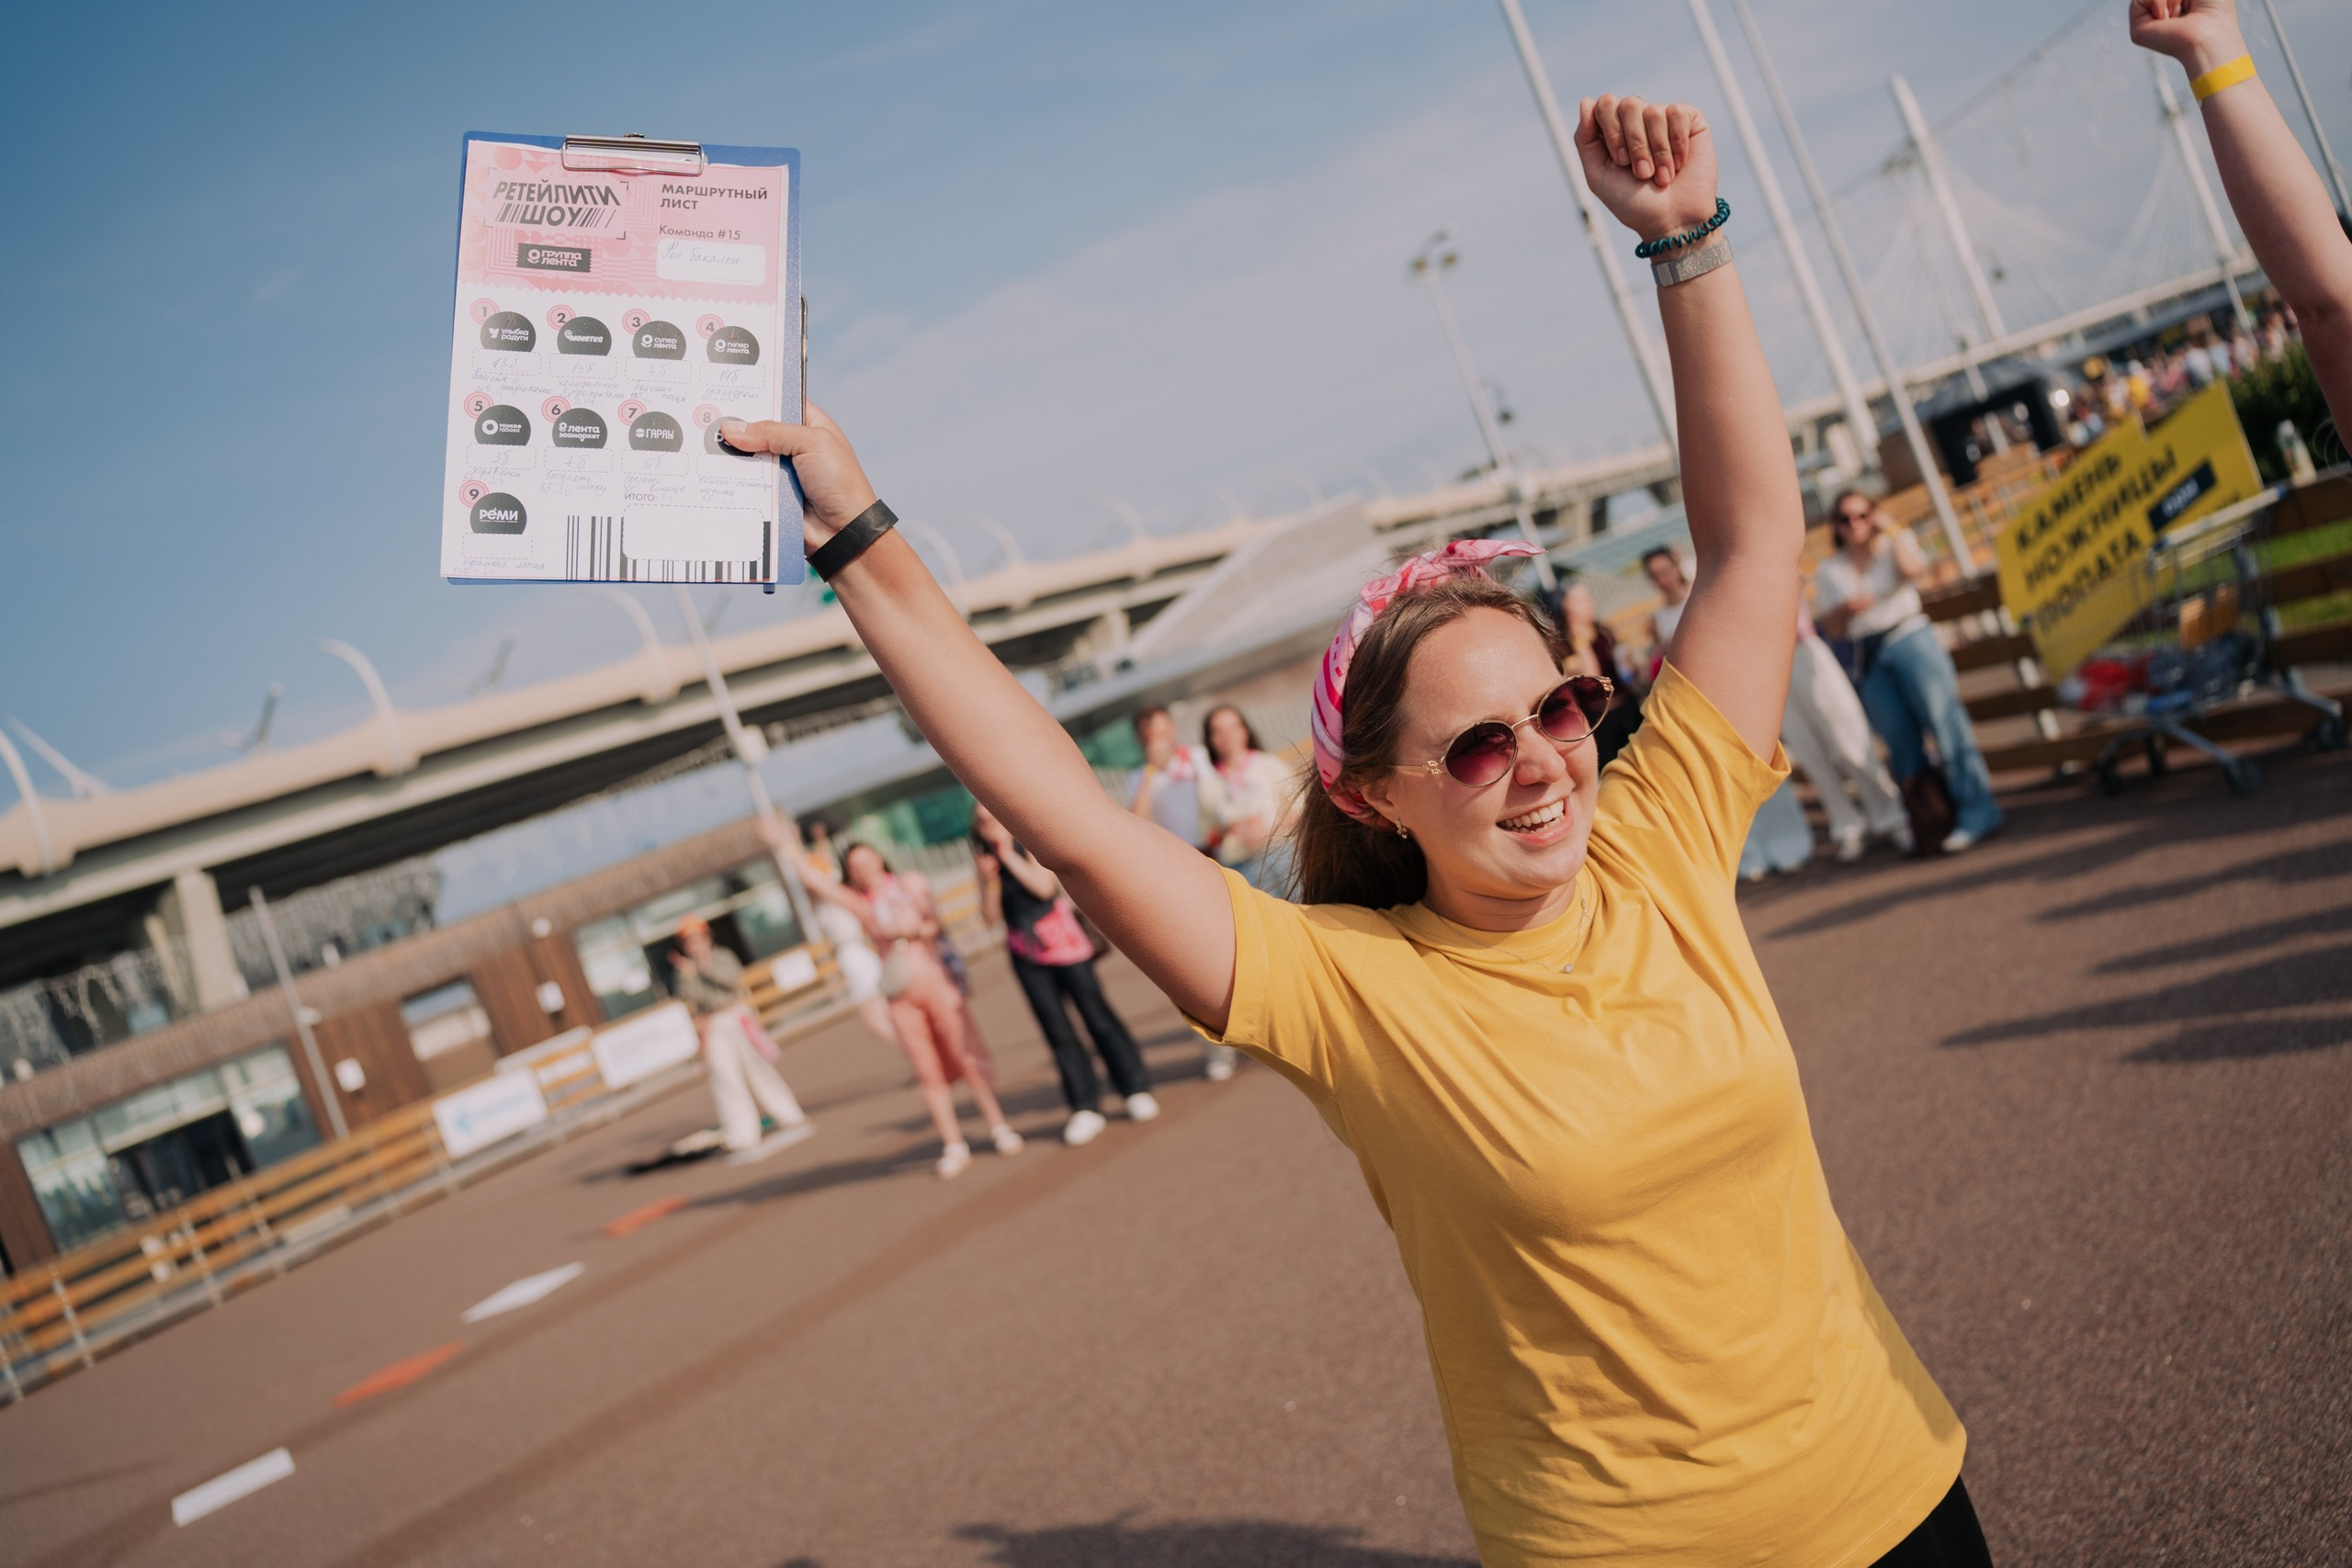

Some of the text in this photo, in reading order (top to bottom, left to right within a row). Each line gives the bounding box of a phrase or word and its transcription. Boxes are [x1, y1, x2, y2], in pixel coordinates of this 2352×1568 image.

[492, 179, 621, 206] РЕТЕЙЛИТИ
[662, 184, 768, 199] МАРШРУТНЫЙ
[660, 197, 699, 209] ЛИСТ
[519, 204, 583, 227] ШОУ
[659, 225, 741, 241] Команда #15
[541, 249, 582, 261] группа
[541, 256, 577, 267] лента
[481, 306, 488, 318] 1
[557, 312, 566, 323] 2
[632, 317, 640, 328] 3
[706, 321, 716, 333] 4
[474, 400, 483, 412] 5
[551, 404, 561, 415] 6
[628, 408, 638, 418] 7
[703, 412, 712, 423] 8
[469, 489, 480, 500] 9
[624, 493, 658, 502] ИТОГО:
